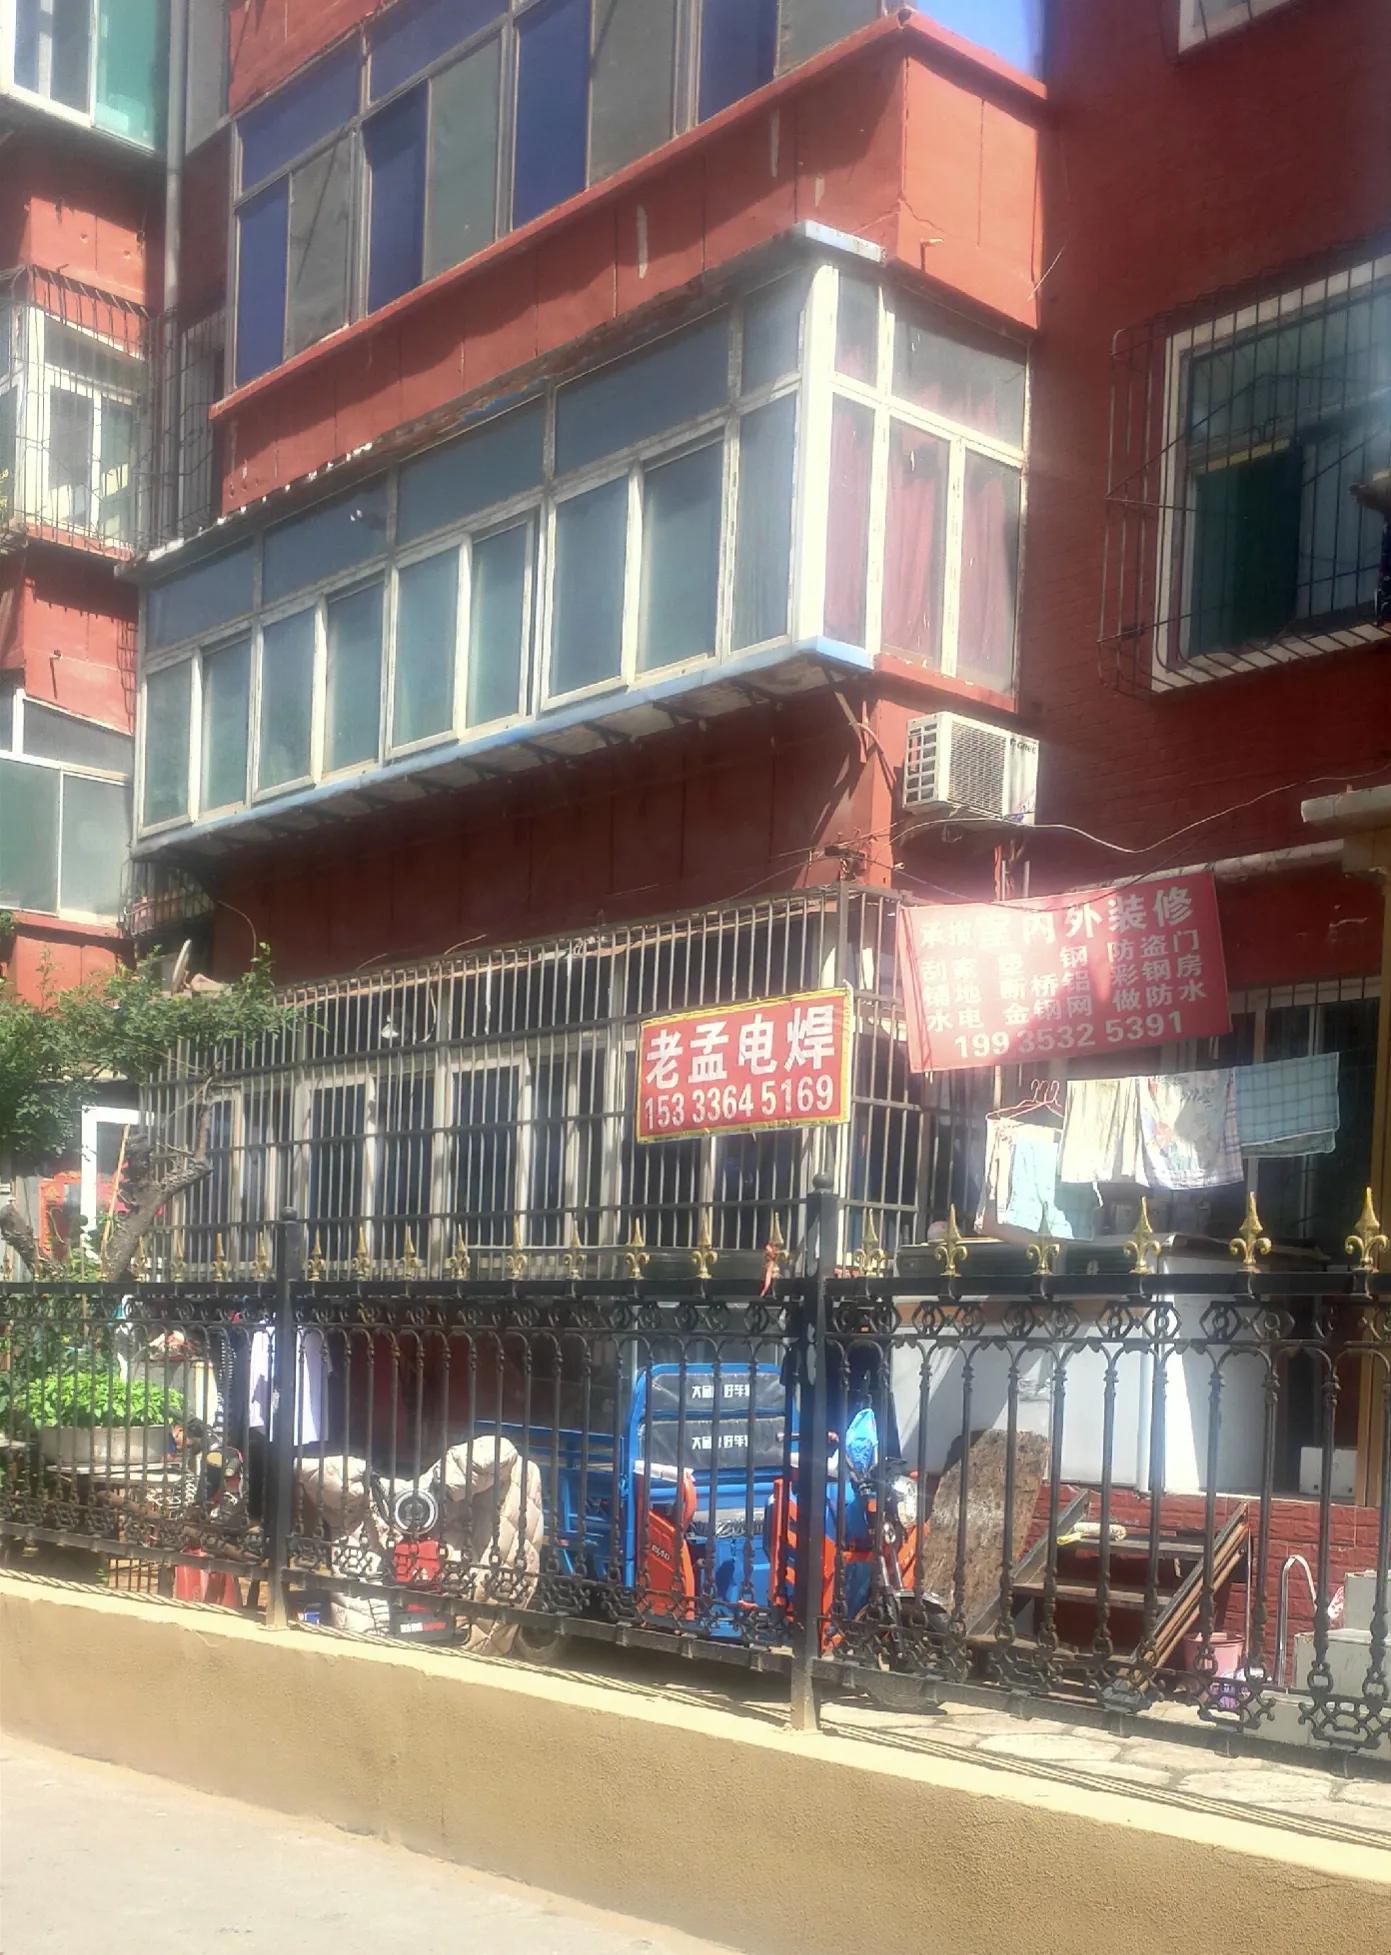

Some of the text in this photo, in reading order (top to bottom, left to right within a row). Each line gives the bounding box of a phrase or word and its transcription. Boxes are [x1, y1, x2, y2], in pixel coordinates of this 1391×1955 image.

[1108, 931, 1200, 963] 防盗门
[1112, 956, 1202, 986] 彩钢房
[928, 1008, 984, 1033] 水电
[1113, 980, 1206, 1012] 做防水
[646, 1005, 834, 1089] 老孟电焊
[954, 1032, 1009, 1059] 199
[1105, 1011, 1182, 1043] 5391
[645, 1075, 833, 1130] 153 3364 5169
